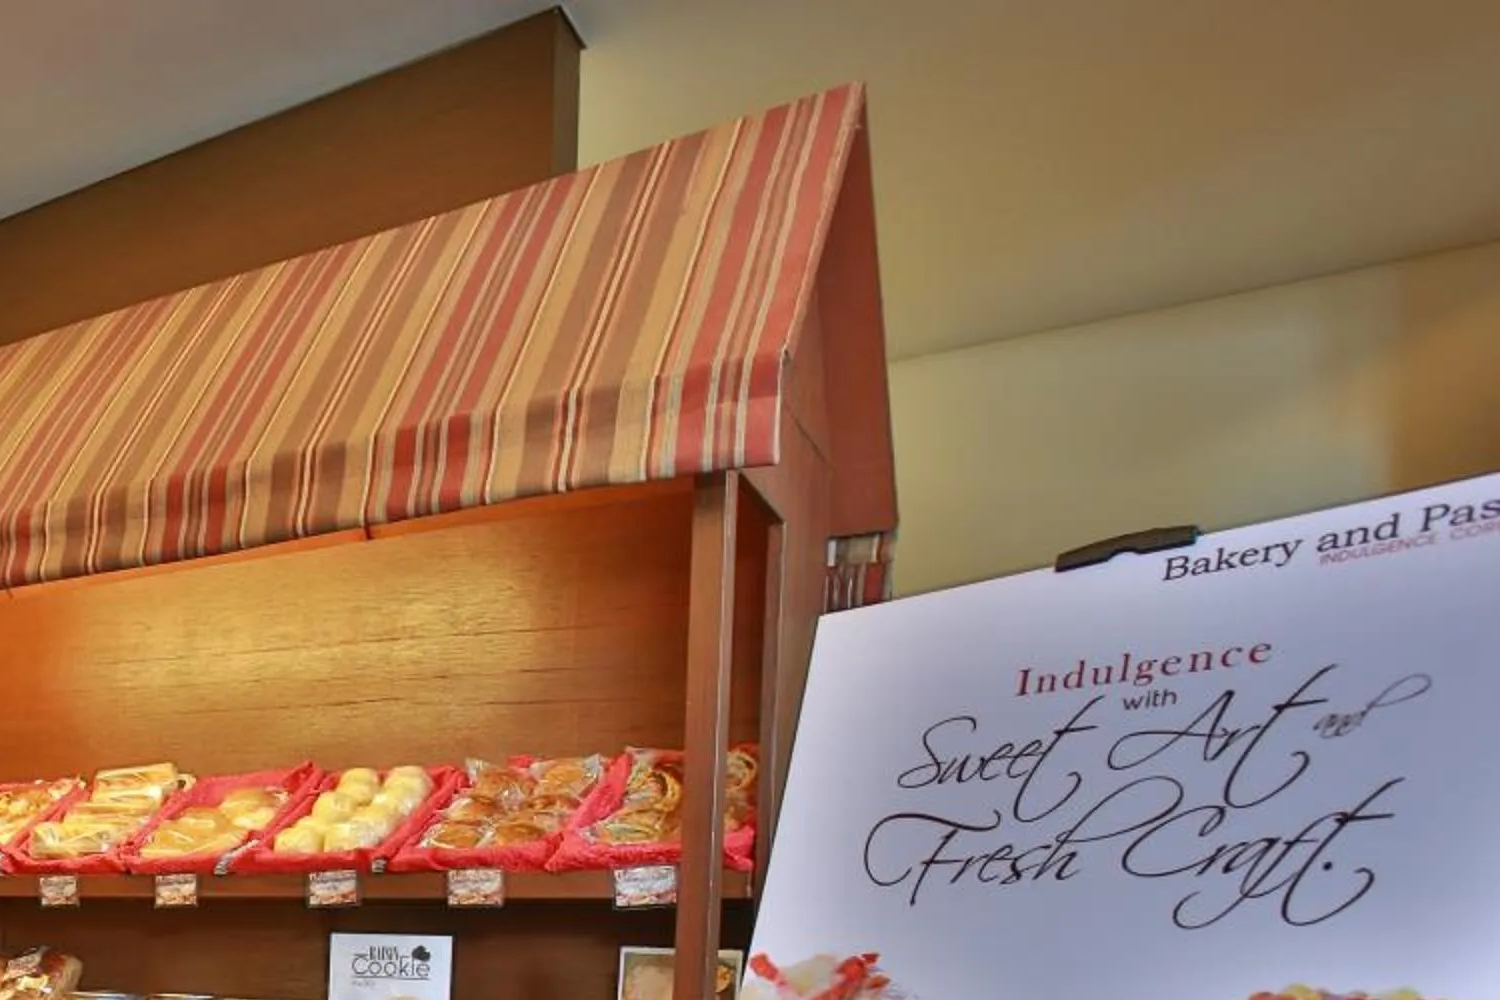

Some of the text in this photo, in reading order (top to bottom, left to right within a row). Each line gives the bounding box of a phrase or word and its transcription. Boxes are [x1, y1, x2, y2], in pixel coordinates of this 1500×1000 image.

[1161, 538, 1303, 582] Bakery
[1315, 512, 1400, 553] and
[1318, 533, 1438, 567] INDULGENCE
[1015, 640, 1272, 698] Indulgence
[1121, 688, 1178, 711] with
[897, 695, 1105, 823] Sweet
[1106, 664, 1338, 809] Art
[863, 775, 1185, 907] Fresh
[351, 954, 431, 977] Cookie
